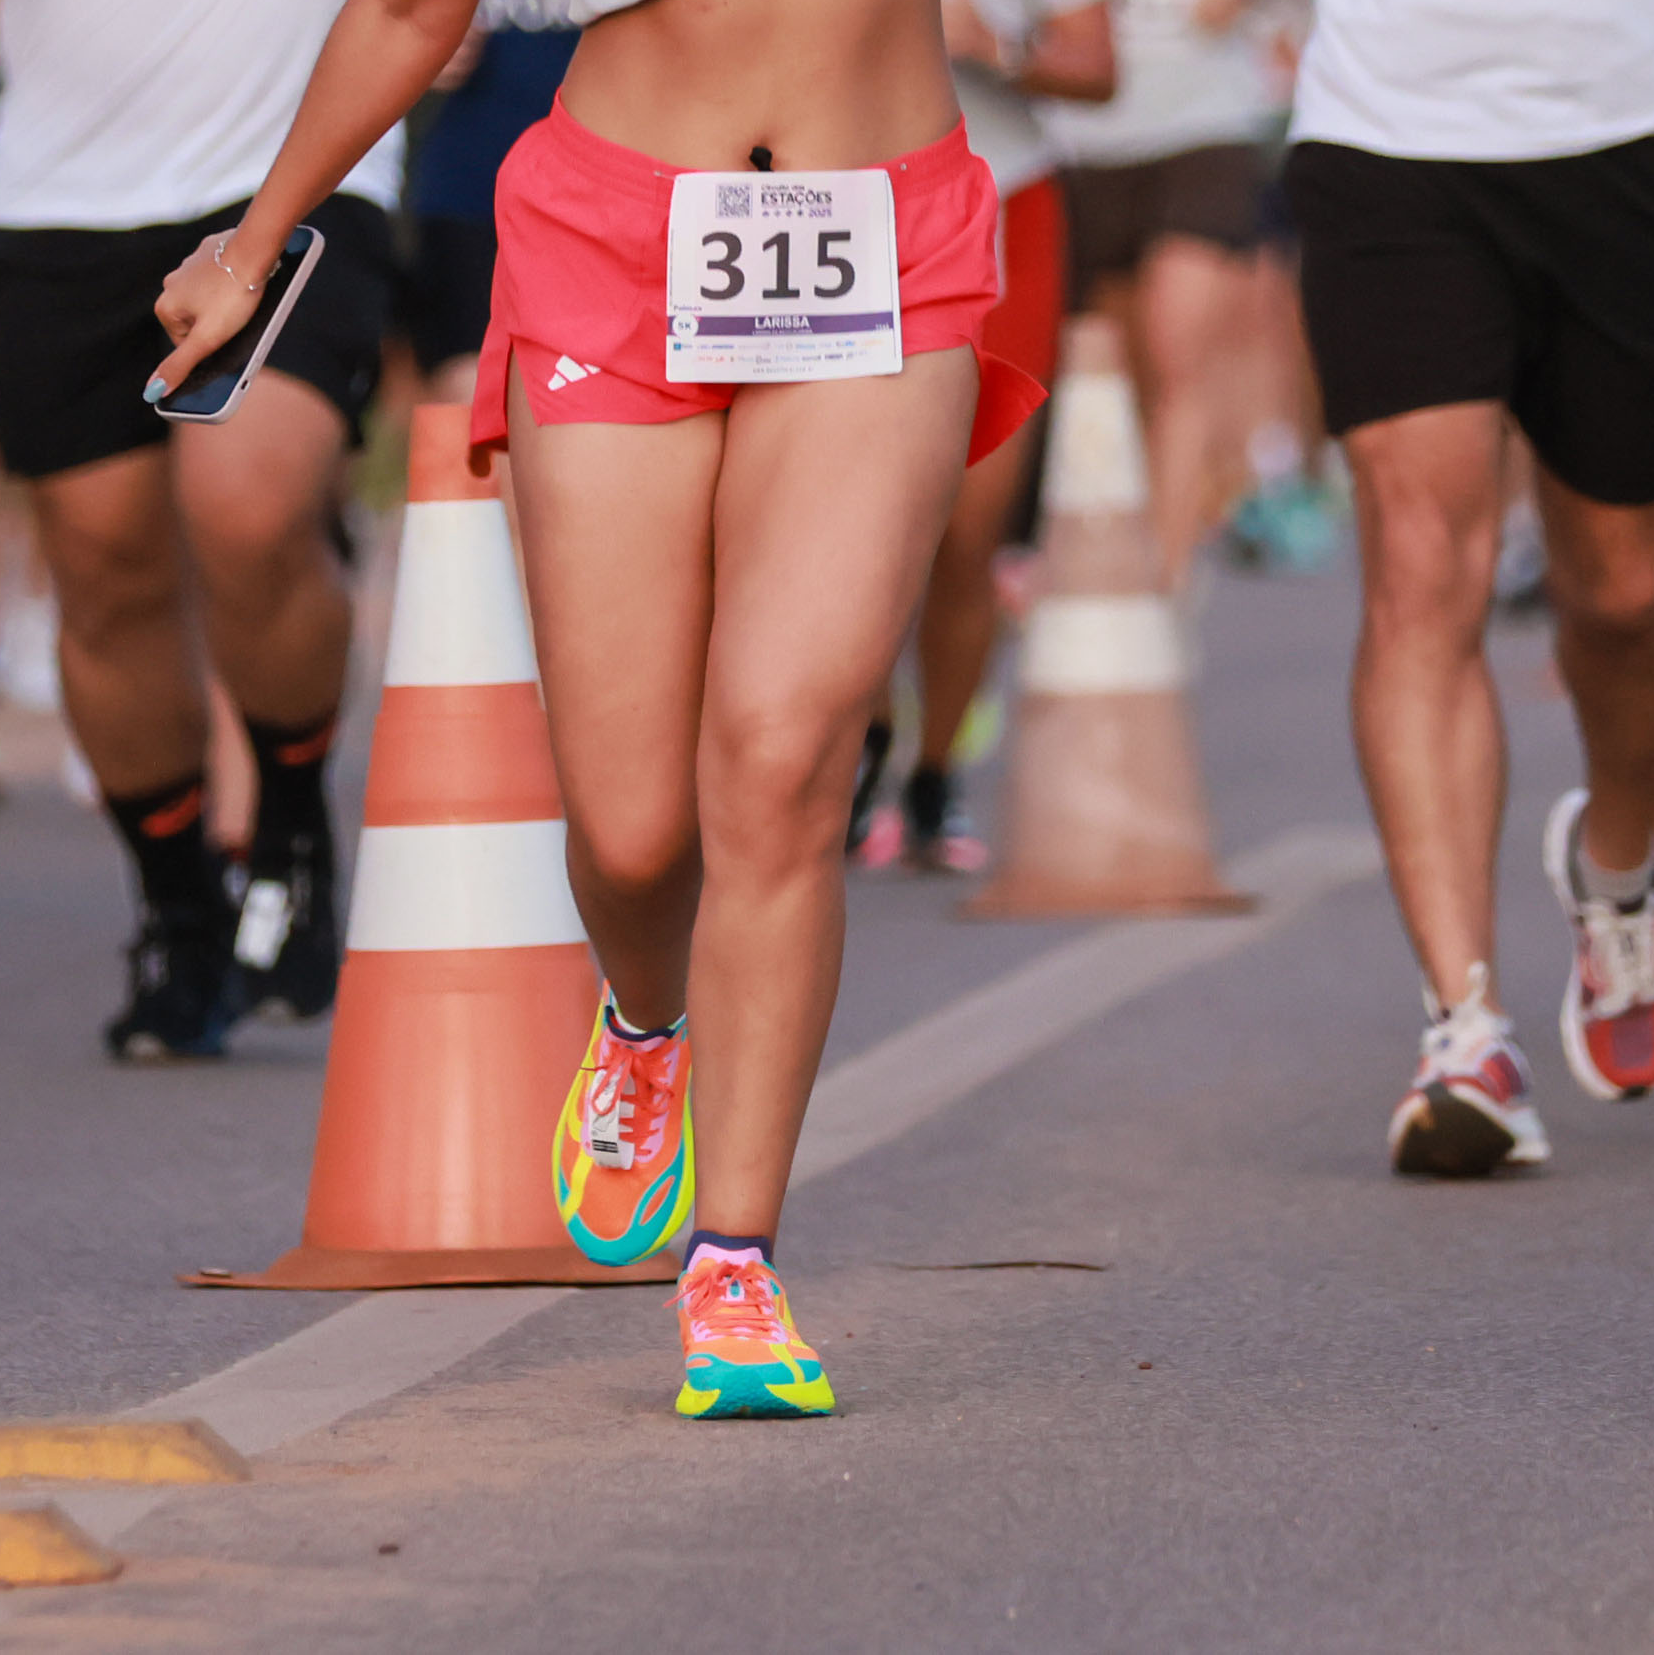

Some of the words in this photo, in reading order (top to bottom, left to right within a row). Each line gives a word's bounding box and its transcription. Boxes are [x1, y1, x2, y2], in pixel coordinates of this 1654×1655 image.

[761, 189, 832, 207] ESTAÇÕES
[700, 230, 856, 300] 315
[754, 315, 811, 329] LARISSA
